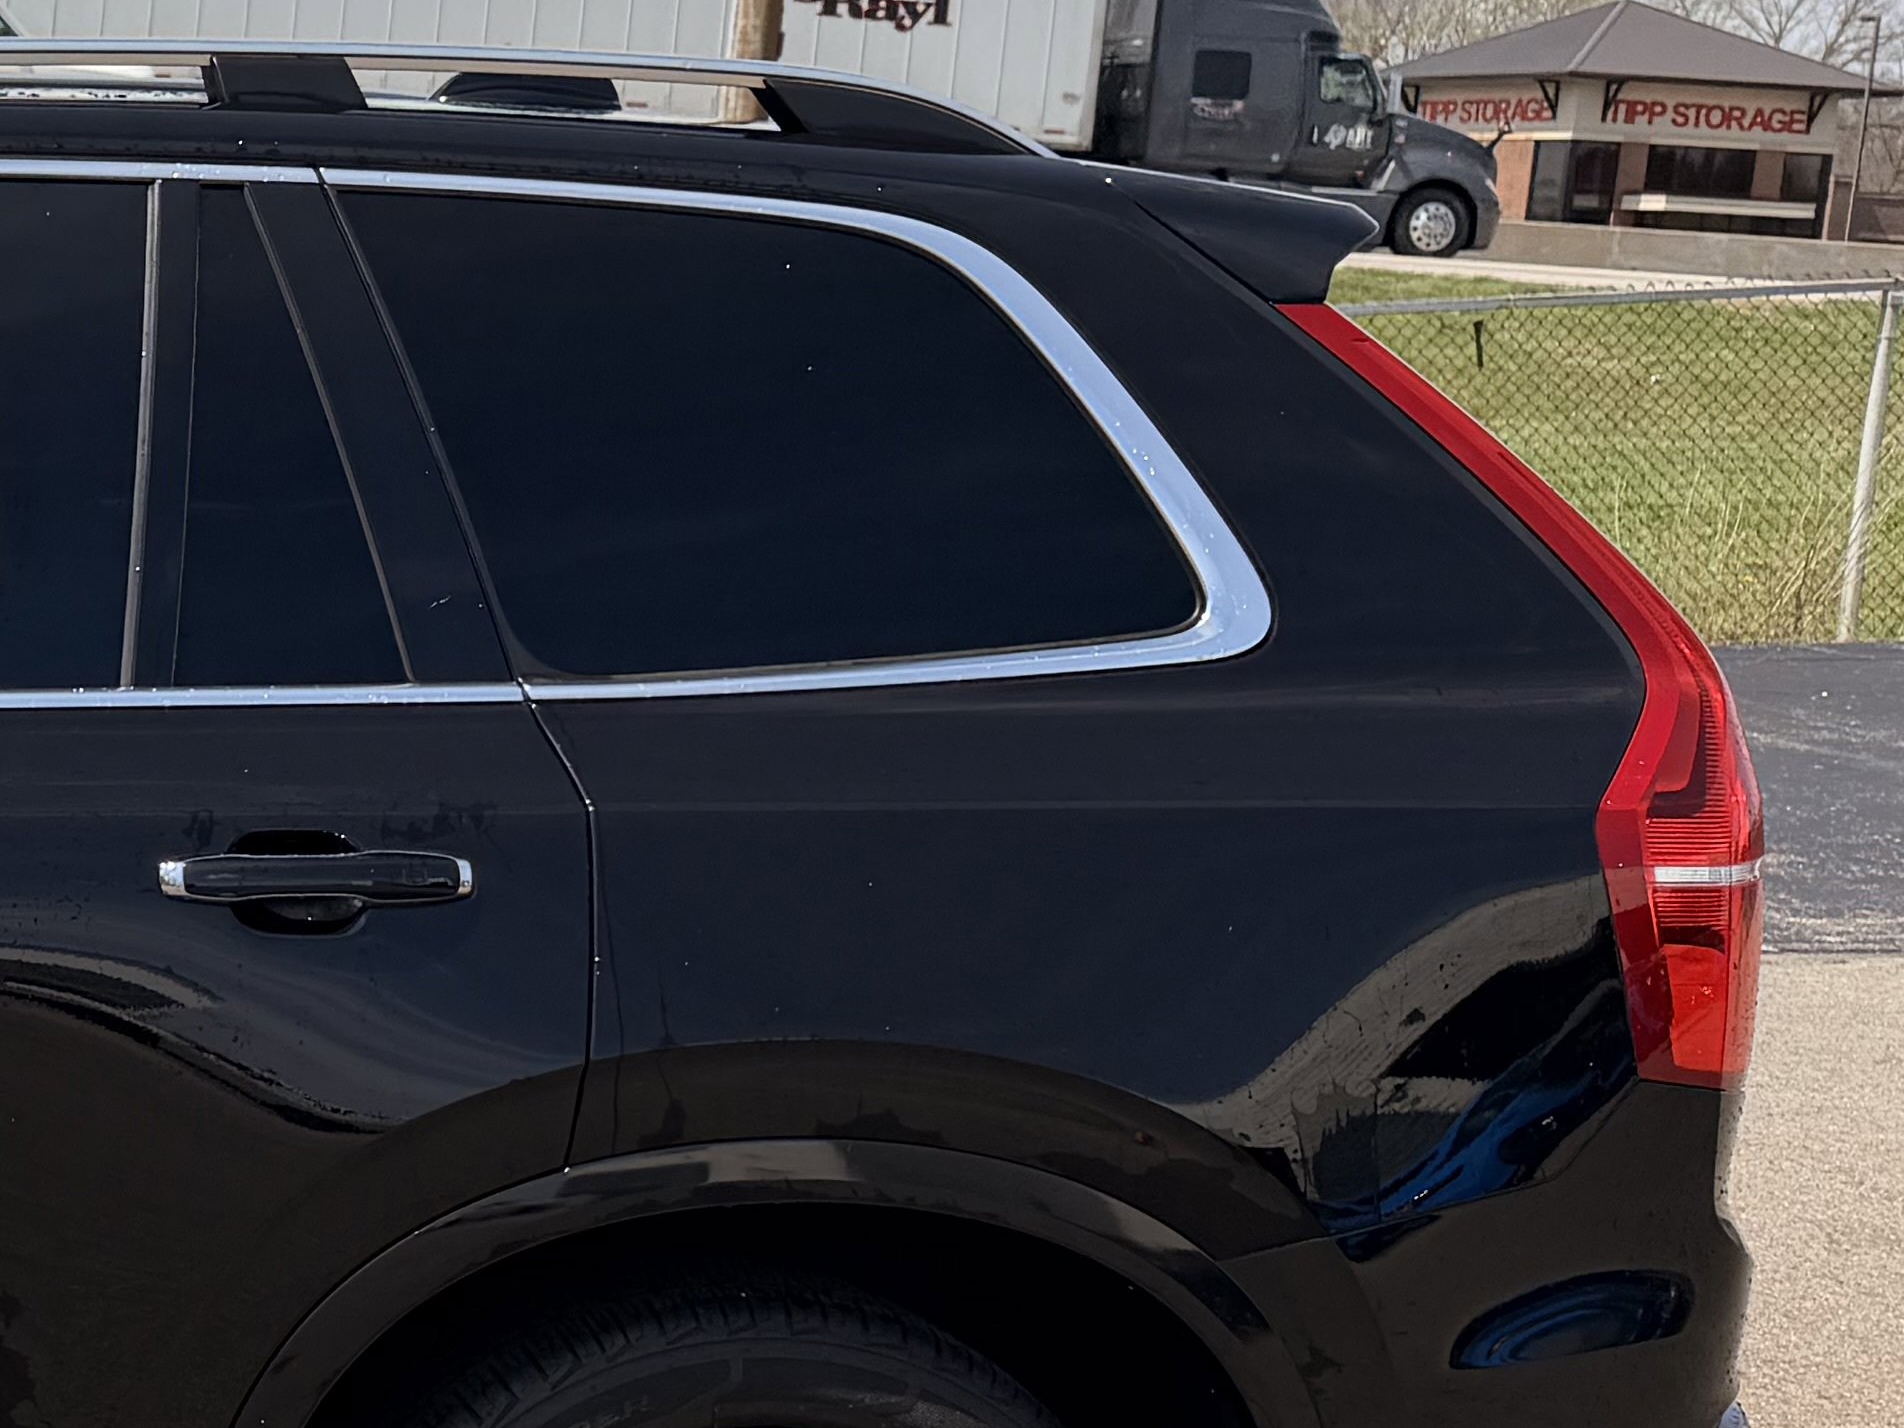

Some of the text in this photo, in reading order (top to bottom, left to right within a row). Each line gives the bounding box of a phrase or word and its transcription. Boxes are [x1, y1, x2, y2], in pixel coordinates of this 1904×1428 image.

[1420, 98, 1554, 125] TIPP STORAGE
[1611, 99, 1809, 135] TIPP STORAGE
